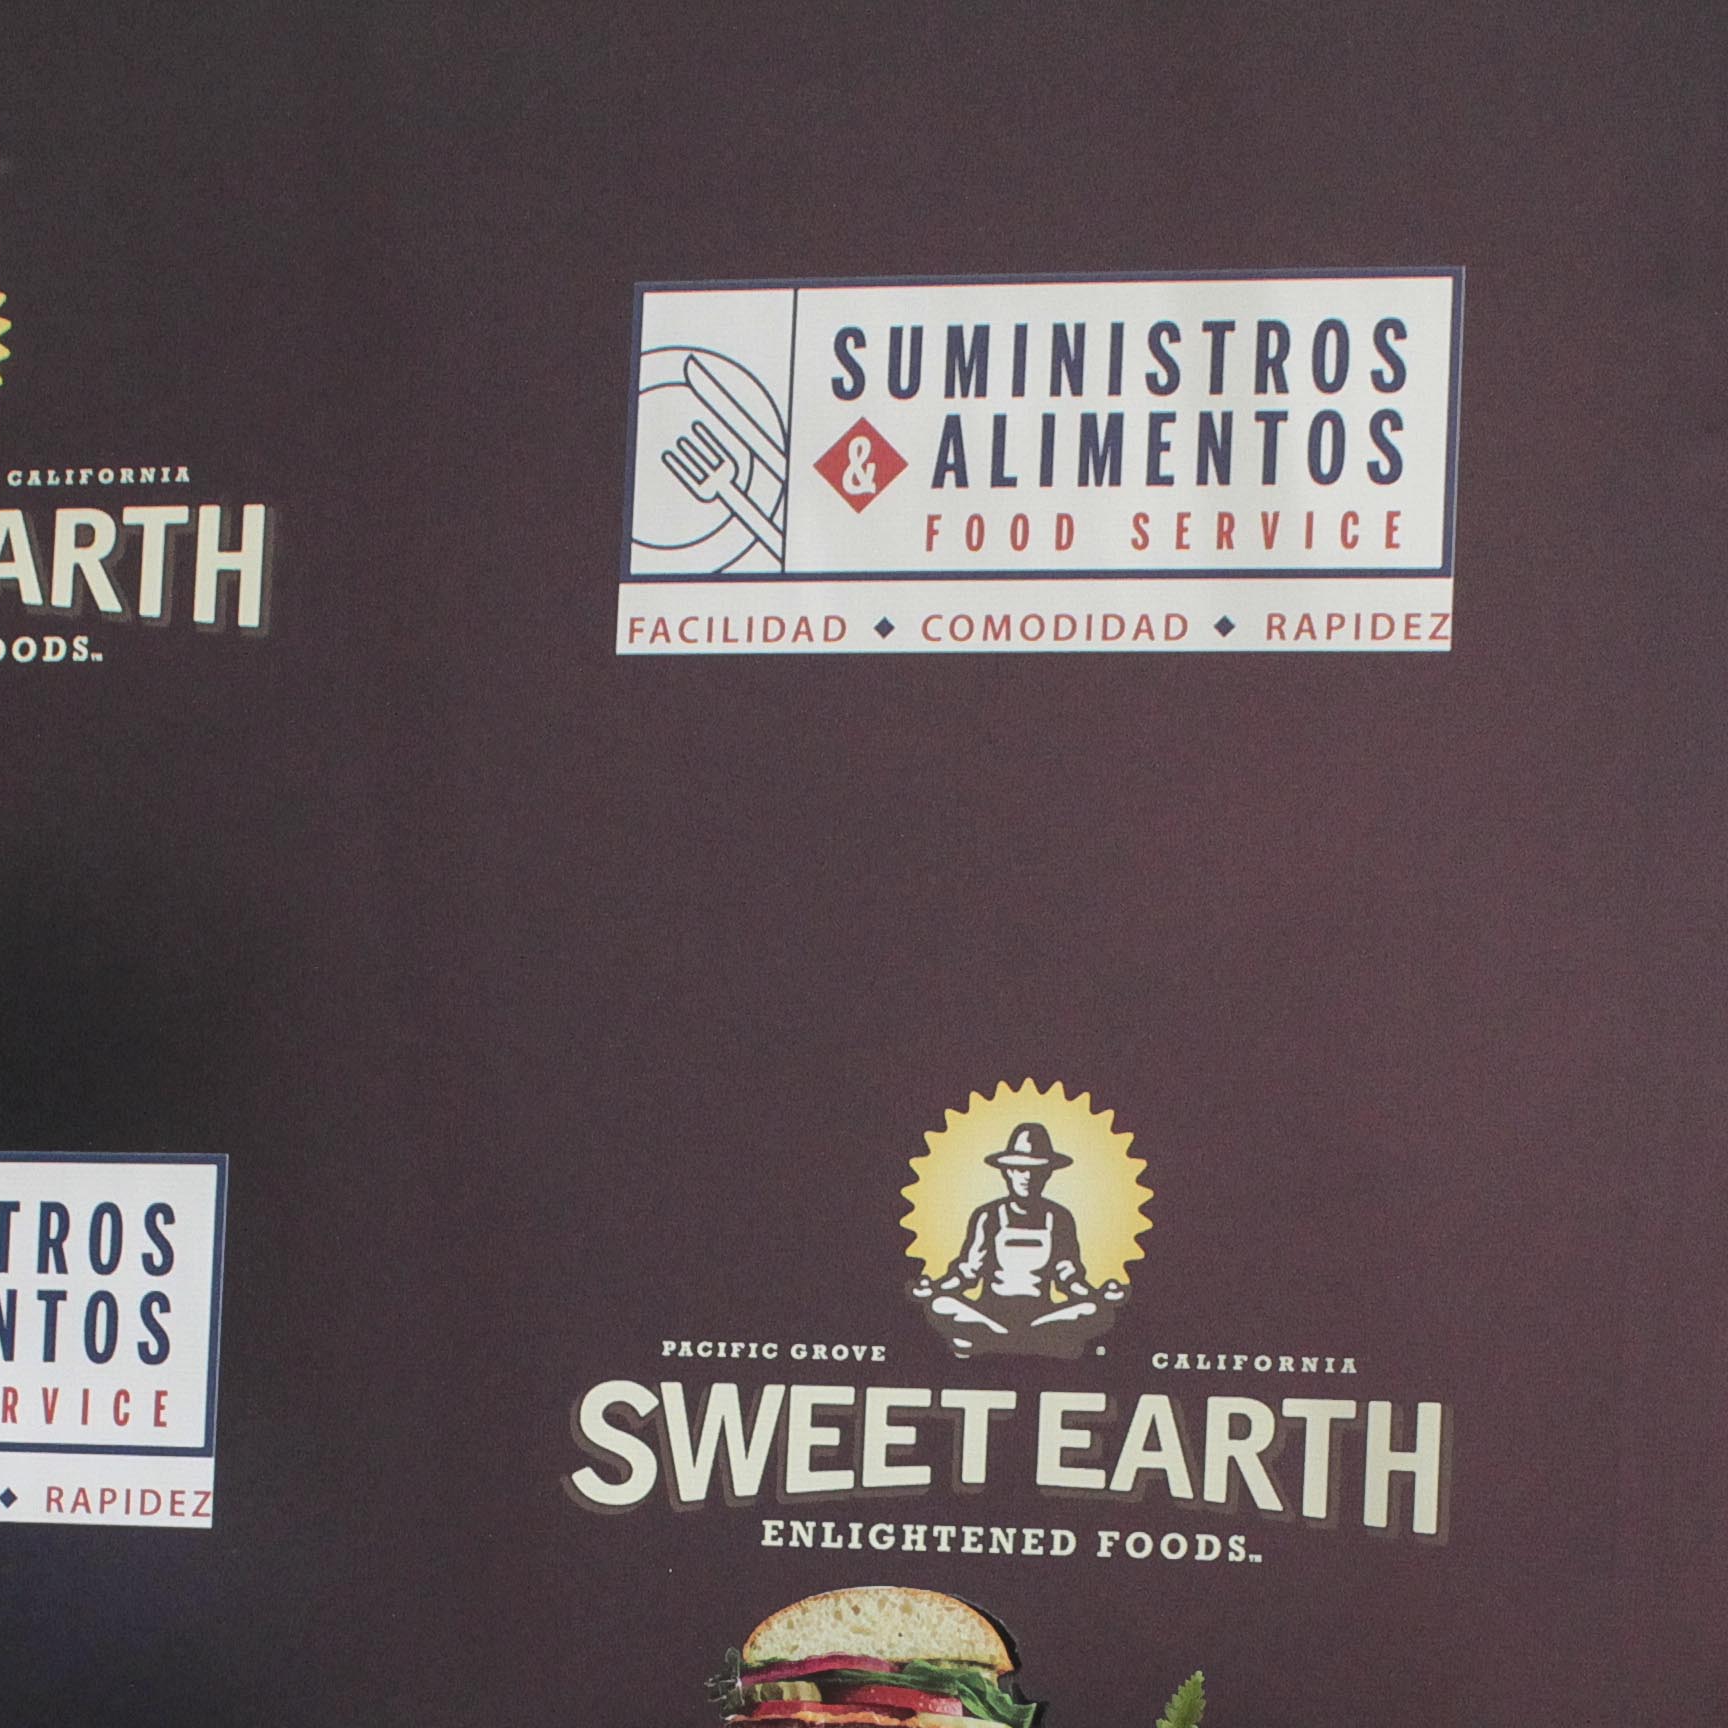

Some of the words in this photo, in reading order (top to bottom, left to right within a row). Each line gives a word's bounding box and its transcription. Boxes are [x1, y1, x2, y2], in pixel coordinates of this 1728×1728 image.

[832, 318, 1409, 401] SUMINISTROS
[842, 436, 876, 494] &
[931, 409, 1404, 489] ALIMENTOS
[7, 466, 192, 488] CALIFORNIA
[927, 513, 1076, 552] FOOD
[1132, 511, 1403, 550] SERVICE
[628, 615, 847, 646] FACILIDAD
[921, 613, 1188, 642] COMODIDAD
[1266, 613, 1451, 641] RAPIDEZ
[662, 1341, 779, 1359] PACIFIC
[790, 1343, 886, 1362] GROVE
[1151, 1351, 1358, 1374] CALIFORNIA
[570, 1380, 1016, 1505] SWEET
[1037, 1392, 1441, 1535] EARTH
[45, 1486, 213, 1518] RAPIDEZ
[760, 1519, 1076, 1556] ENLIGHTENED
